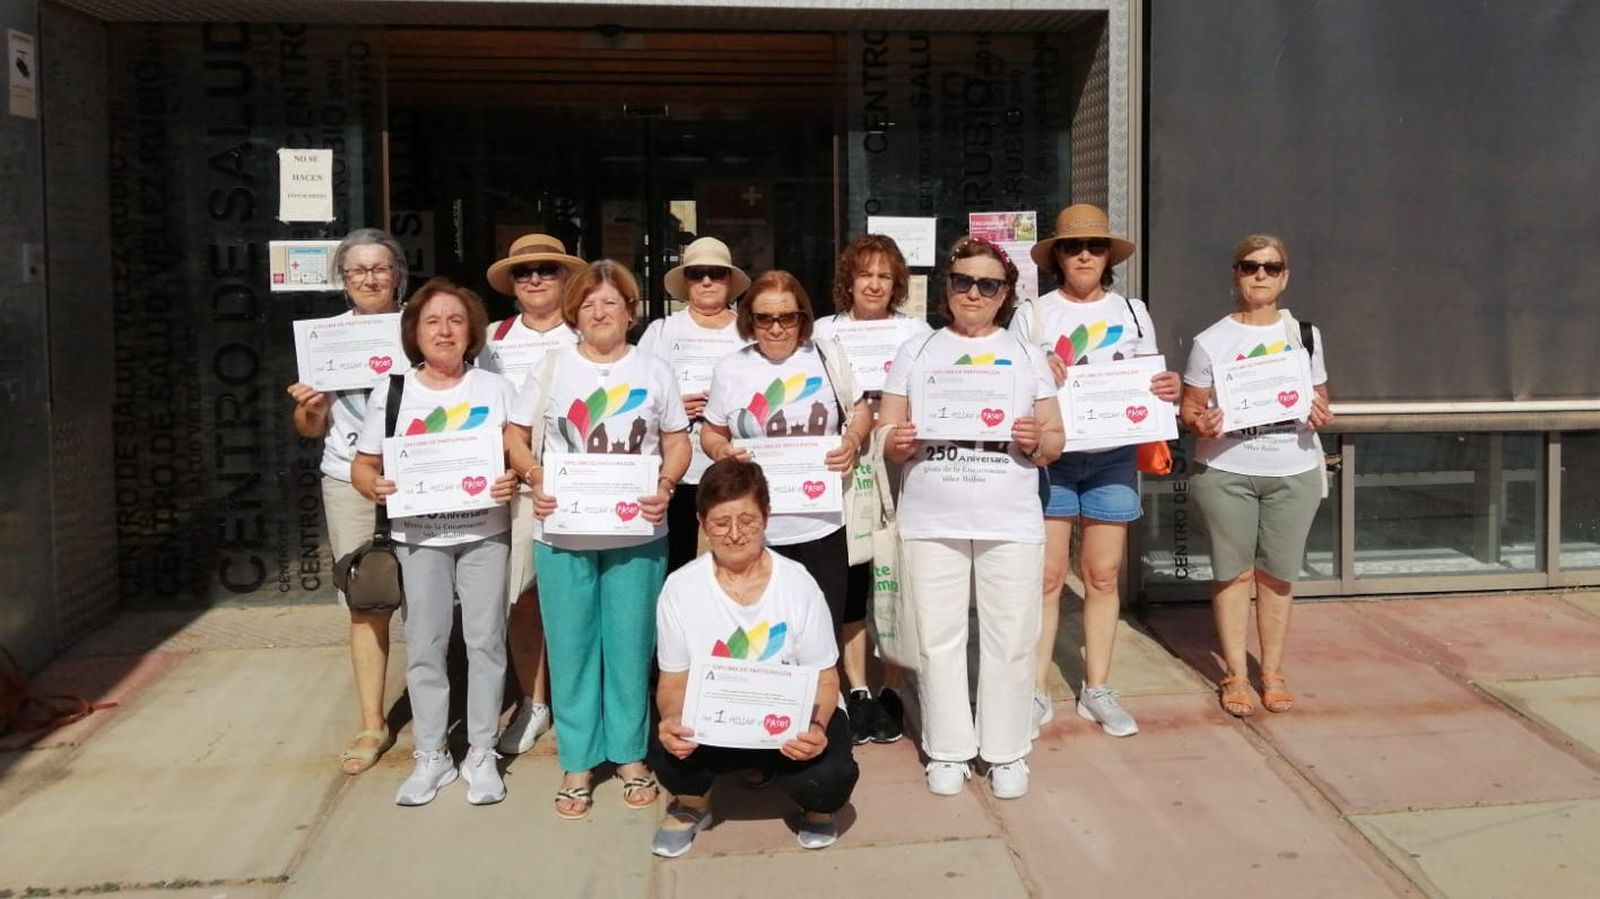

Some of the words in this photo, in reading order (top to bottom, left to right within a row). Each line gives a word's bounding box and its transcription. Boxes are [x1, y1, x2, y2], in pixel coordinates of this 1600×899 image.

[205, 22, 254, 223] SALUD
[963, 79, 993, 207] RUBIO
[209, 244, 258, 323] DE
[211, 343, 266, 594] CENTRO
[300, 457, 319, 488] DE
[925, 445, 958, 461] 250
[958, 455, 1010, 464] Aniversario
[1172, 481, 1187, 505] DE
[299, 495, 320, 592] CENTRO
[1173, 508, 1188, 580] CENTRO
